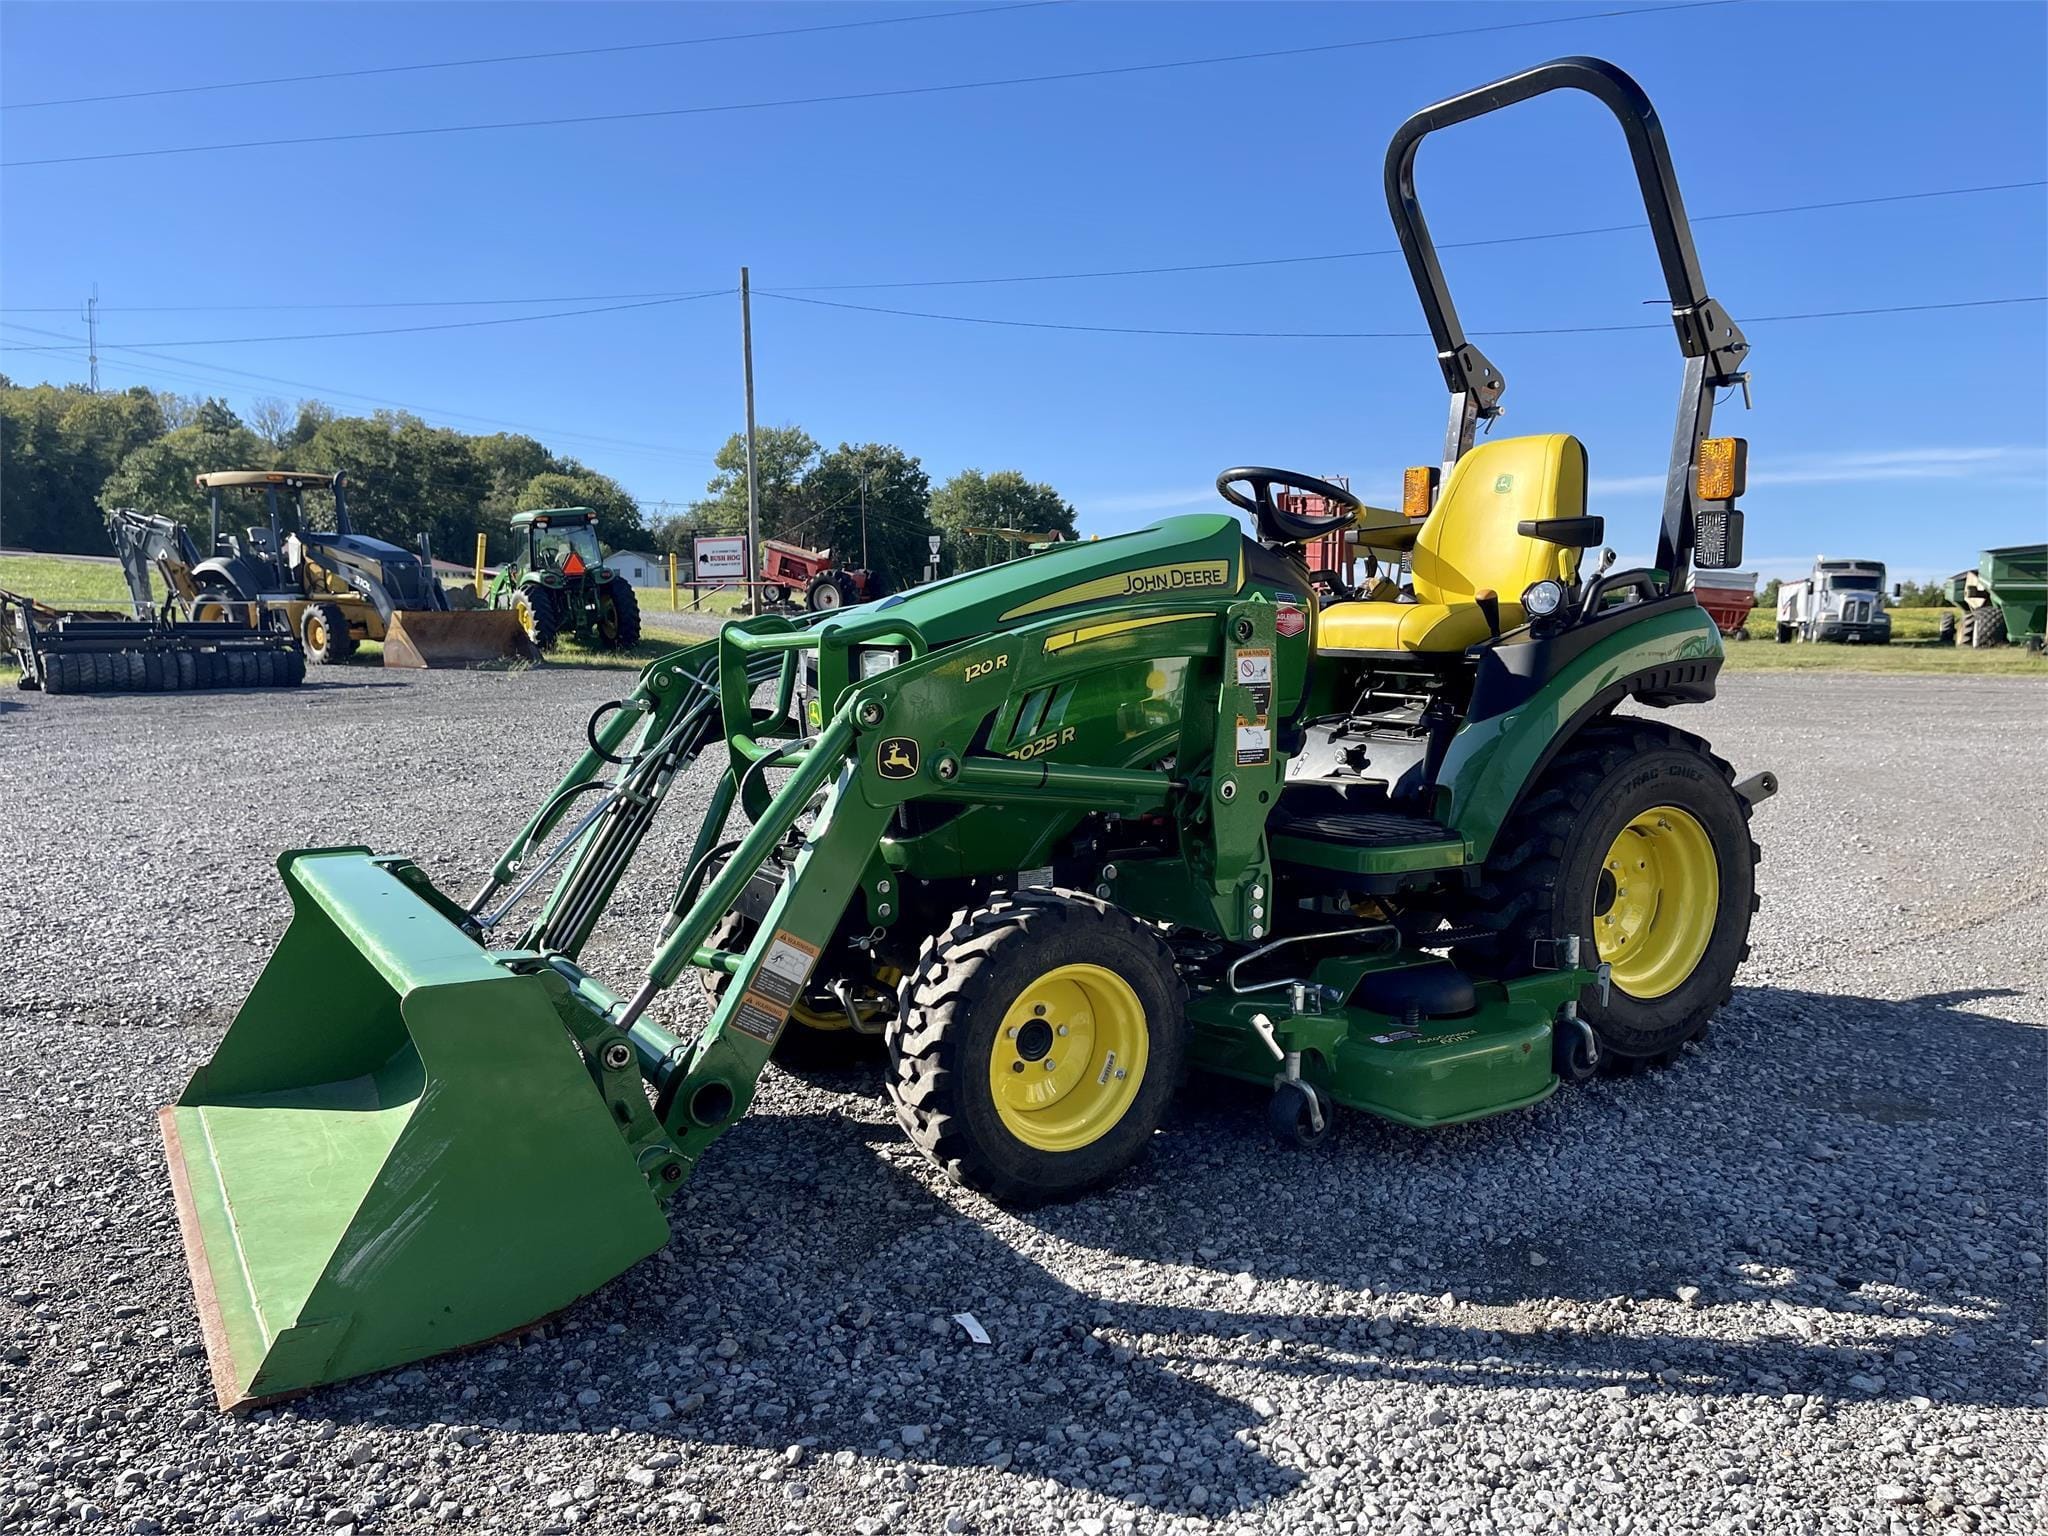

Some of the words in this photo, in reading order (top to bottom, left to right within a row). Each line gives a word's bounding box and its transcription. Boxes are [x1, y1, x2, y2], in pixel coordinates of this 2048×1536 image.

[1123, 574, 1168, 593] JOHN
[1170, 569, 1222, 586] DEERE
[1243, 649, 1269, 657] WARNING
[964, 660, 994, 683] 120
[996, 654, 1009, 670] R
[1061, 726, 1076, 745] R
[1625, 768, 1659, 794] TRAC
[787, 936, 815, 954] WARNING
[755, 1000, 783, 1017] WARNING
